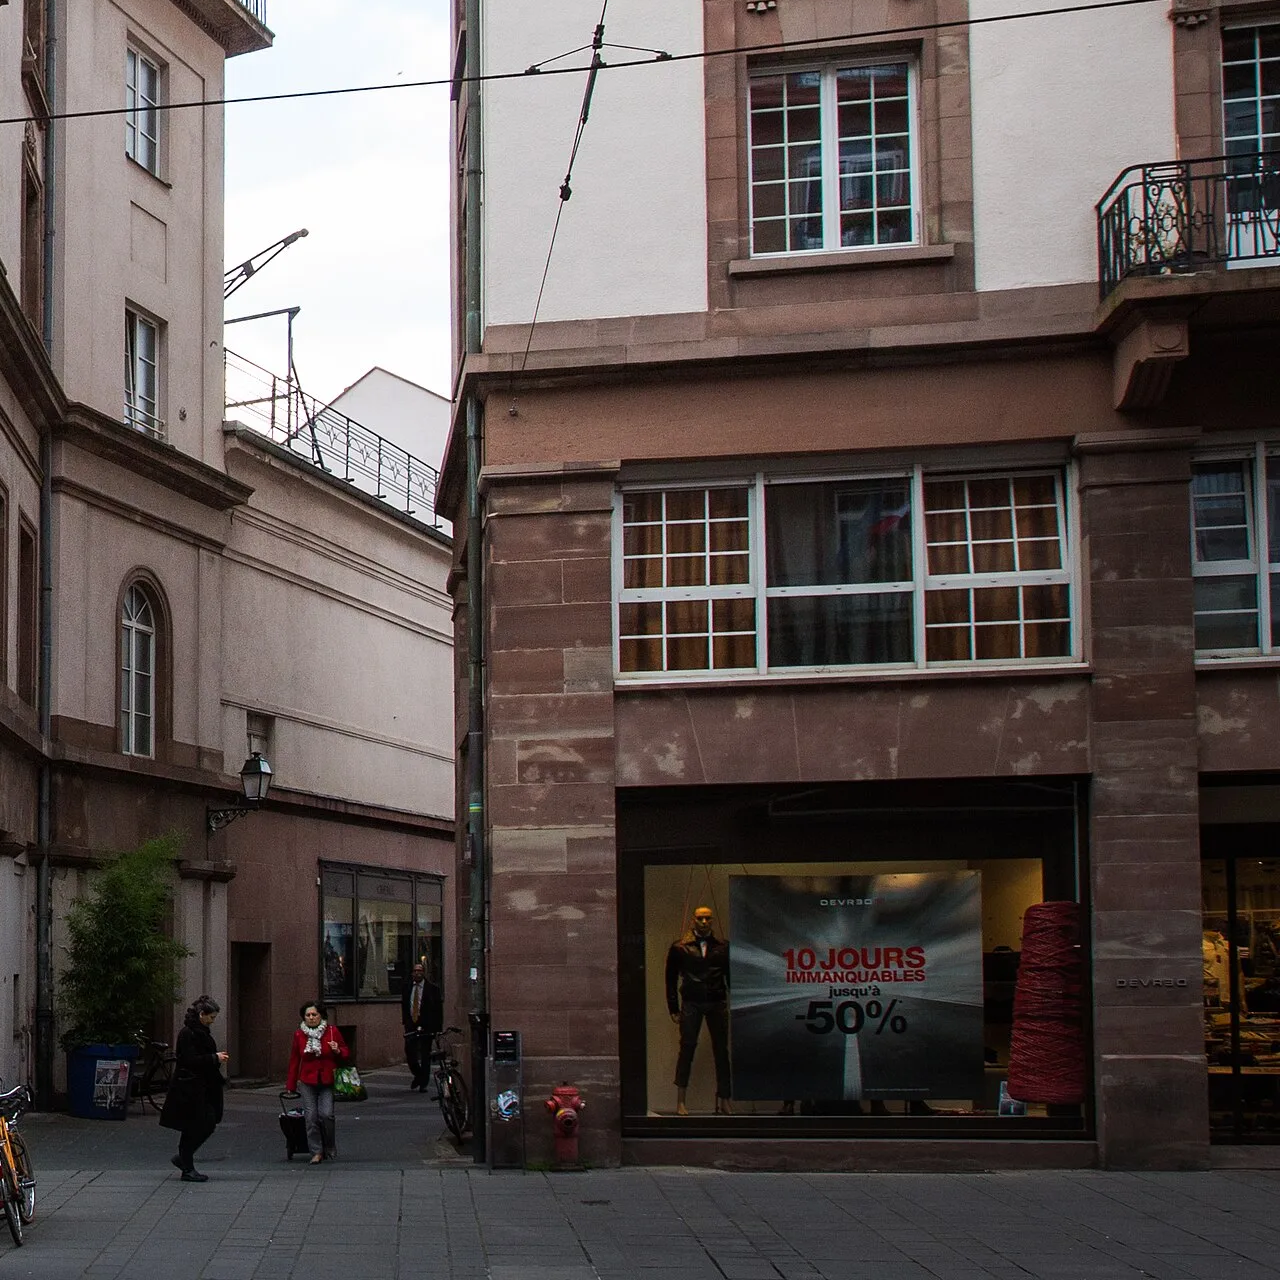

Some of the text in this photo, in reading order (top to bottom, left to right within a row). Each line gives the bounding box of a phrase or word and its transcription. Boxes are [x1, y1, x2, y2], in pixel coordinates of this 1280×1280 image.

[783, 946, 926, 970] 10 JOURS
[786, 969, 926, 983] IMMANQUABLES
[828, 985, 881, 999] jusqu'à
[795, 998, 908, 1035] -50%
